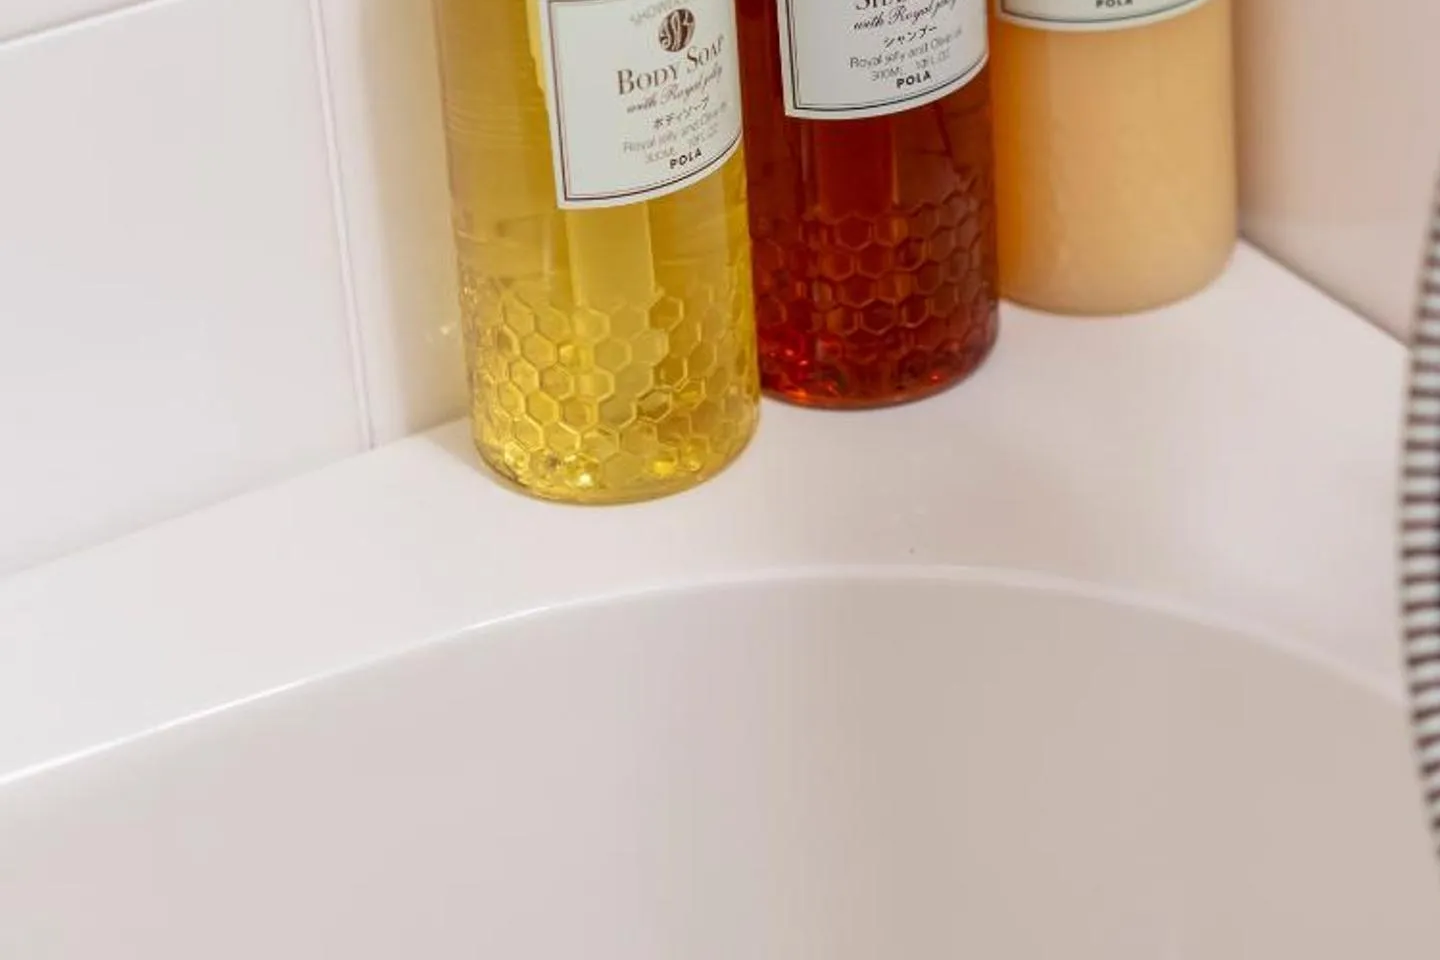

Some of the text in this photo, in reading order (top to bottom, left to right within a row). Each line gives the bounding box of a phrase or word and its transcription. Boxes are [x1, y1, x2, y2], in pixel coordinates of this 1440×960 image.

[853, 11, 885, 30] with
[617, 33, 725, 95] BODY SOAP
[896, 70, 931, 88] POLA
[669, 148, 702, 170] POLA
